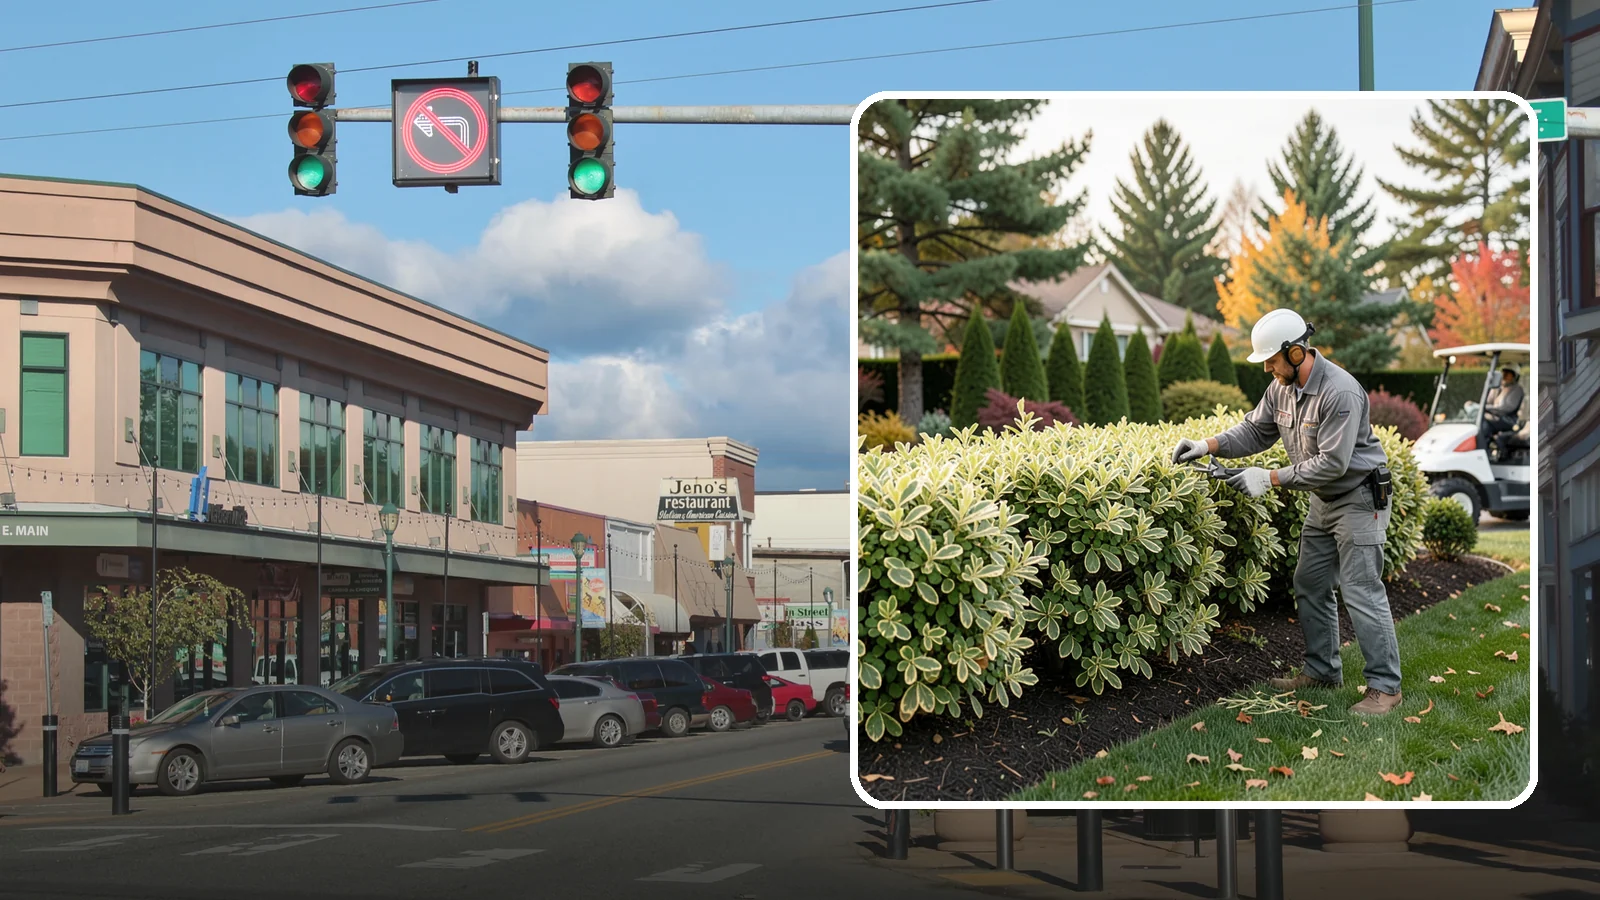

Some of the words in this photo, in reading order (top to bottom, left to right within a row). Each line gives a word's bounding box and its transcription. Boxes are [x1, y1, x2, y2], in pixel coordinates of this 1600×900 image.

[670, 480, 727, 494] Jeno's
[665, 496, 731, 509] restaurant
[659, 510, 681, 519] Italian
[686, 510, 714, 519] American
[715, 510, 737, 519] Cuisine
[2, 525, 13, 536] E.
[15, 525, 49, 536] MAIN
[785, 607, 795, 616] in
[797, 607, 828, 616] Street
[791, 619, 823, 627] lass
